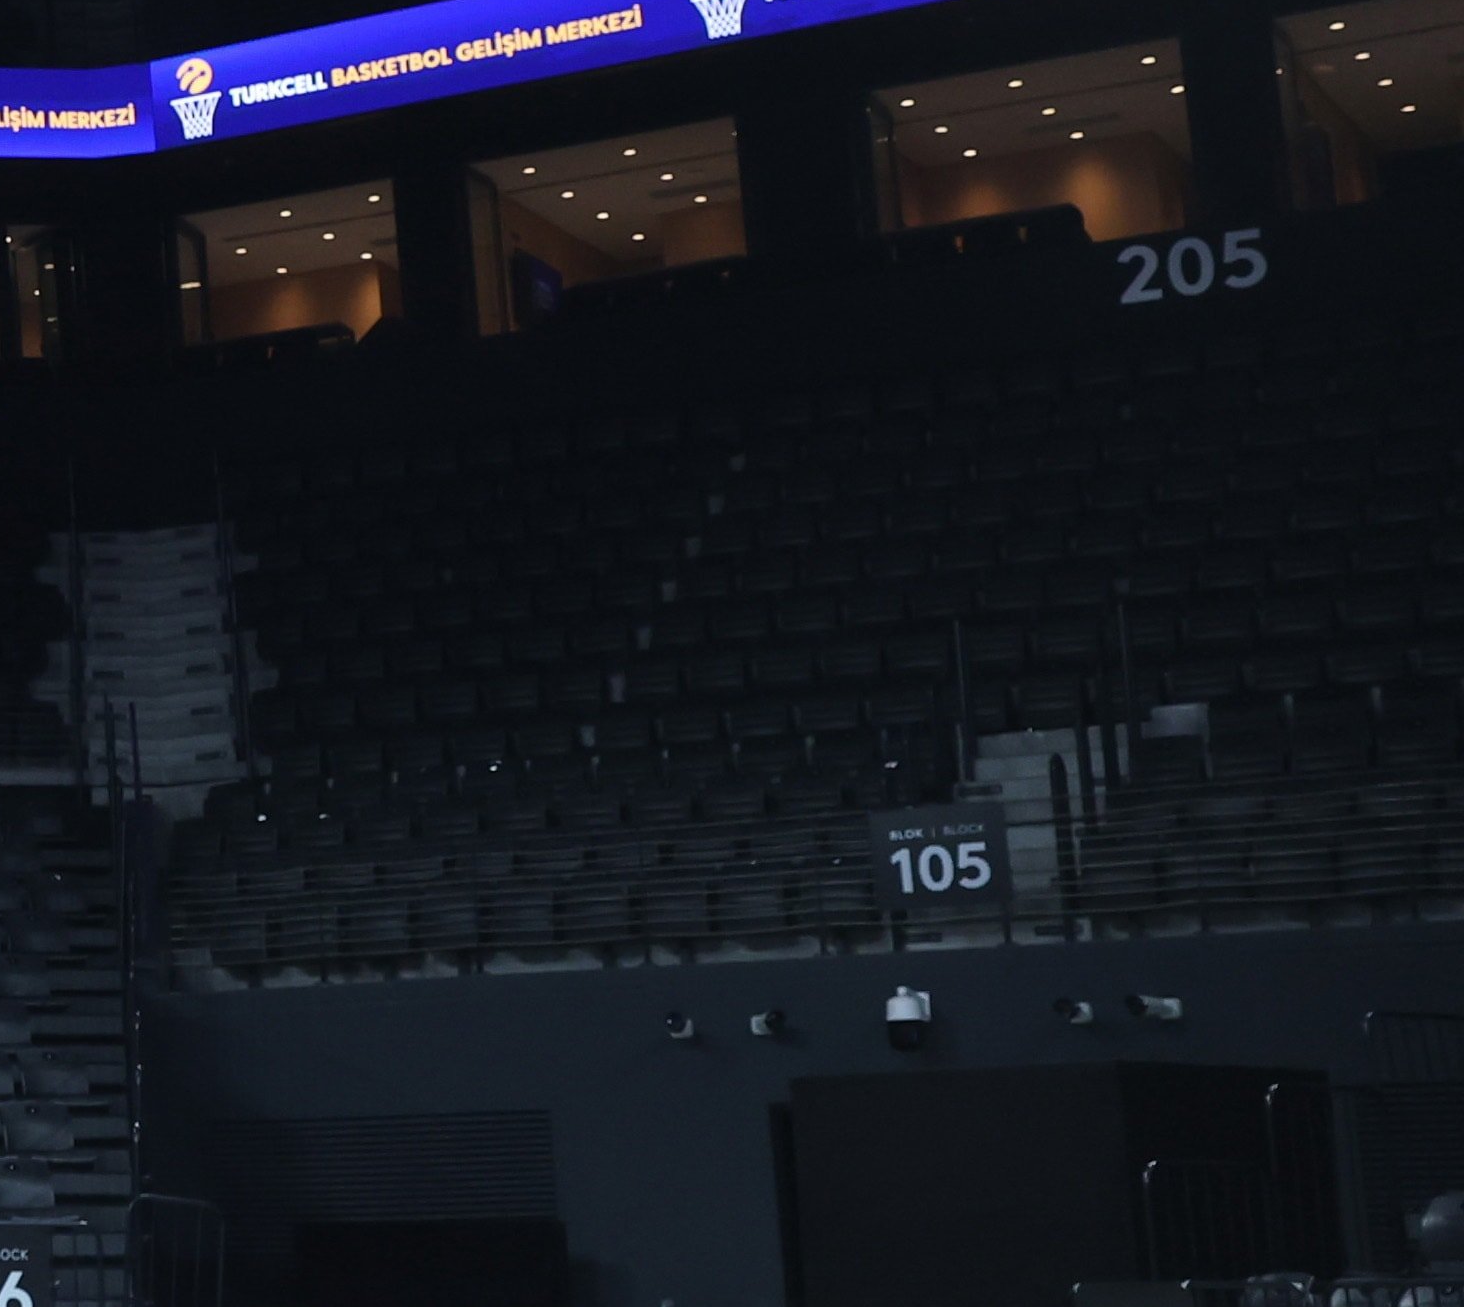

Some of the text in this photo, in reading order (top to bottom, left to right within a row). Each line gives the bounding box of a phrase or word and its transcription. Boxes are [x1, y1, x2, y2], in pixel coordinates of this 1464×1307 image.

[228, 3, 643, 107] TURKCELL BASKETBOL GELİŞİM MERKEZİ
[48, 102, 136, 130] MERKEZİ
[1117, 227, 1268, 304] 205
[889, 841, 992, 894] 105
